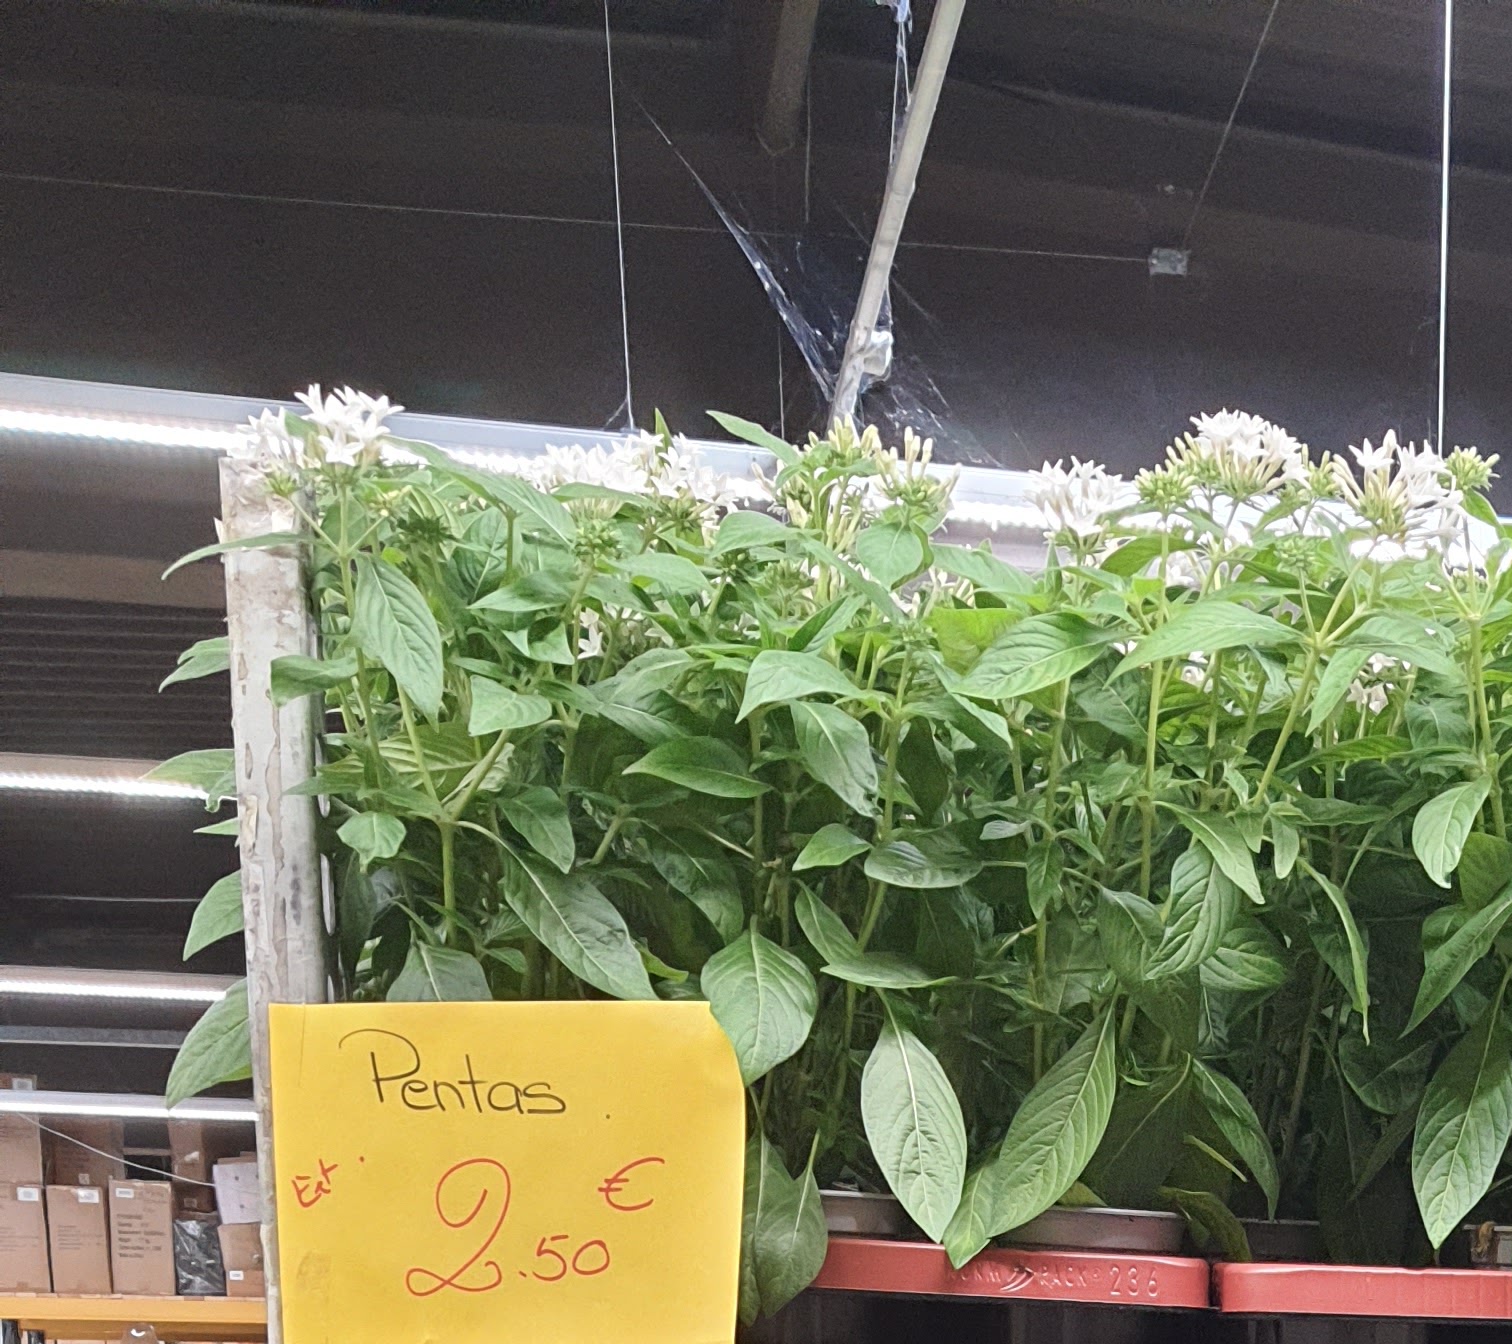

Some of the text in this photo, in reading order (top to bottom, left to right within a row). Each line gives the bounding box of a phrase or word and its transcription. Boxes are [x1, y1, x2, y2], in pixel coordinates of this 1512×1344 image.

[406, 1157, 666, 1297] 2.50 €
[1107, 1262, 1160, 1298] 236
